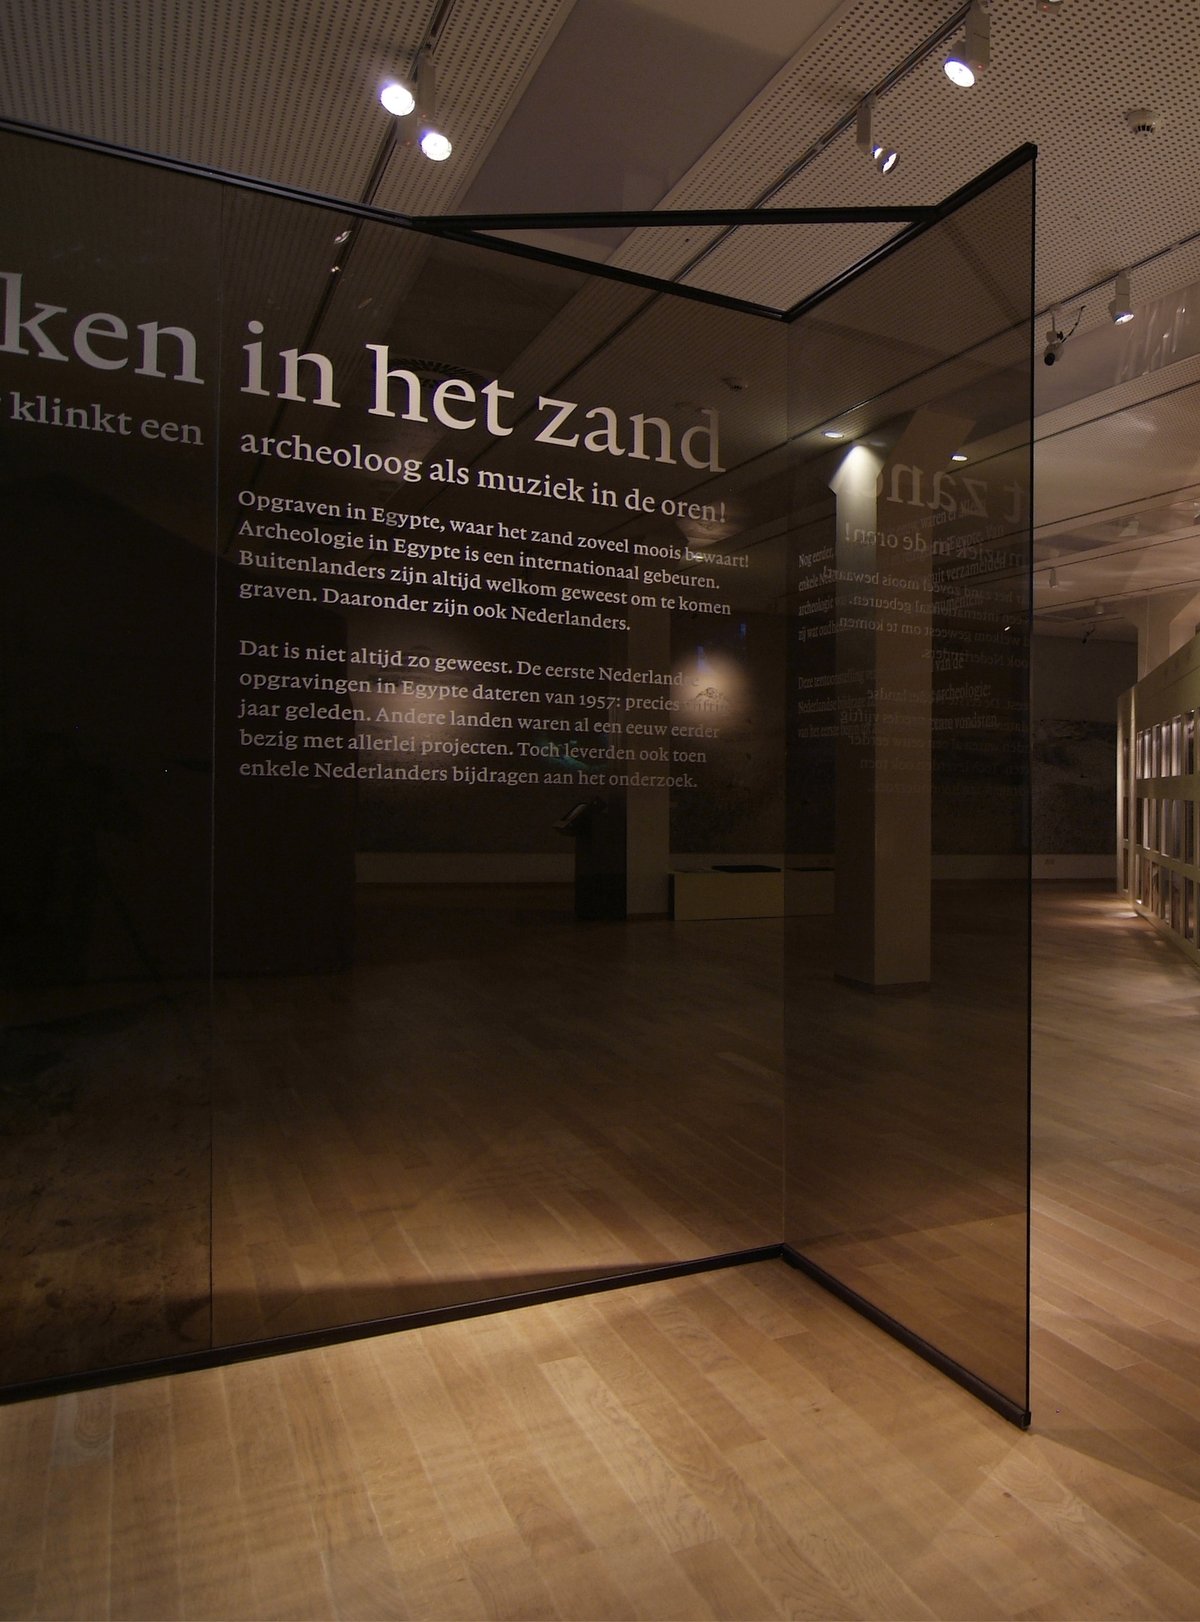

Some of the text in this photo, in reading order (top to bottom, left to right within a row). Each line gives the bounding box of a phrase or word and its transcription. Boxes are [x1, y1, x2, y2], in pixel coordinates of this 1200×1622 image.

[0, 271, 726, 473] ken in het zand
[9, 391, 205, 446] klinkt een
[240, 432, 727, 524] archeoloog als muziek in de oren!
[238, 490, 750, 568] Opgraven in Egypte, waar het zand zoveel moois bewaart!
[238, 519, 721, 590] Archeologie in Egypte is een internationaal gebeuren.
[238, 549, 732, 616] Buitenlanders zijn altijd welkom geweest om te komen
[239, 583, 632, 631] graven. Daaronder zijn ook Nederlanders.
[239, 640, 701, 687] Dat is niet altijd zo geweest. De eerste Nederland
[239, 671, 372, 695] opgravingen
[376, 678, 397, 694] in
[401, 680, 469, 701] Egypte
[472, 684, 541, 705] dateren
[545, 690, 576, 706] van
[578, 694, 621, 711] 1957:
[625, 695, 680, 713] precies
[237, 699, 720, 739] jaar geleden. Andere landen waren al een eeuw eerder
[239, 728, 708, 763] bezig met allerlei projecten. Toch leverden ook toen
[239, 759, 698, 789] enkele Nederlanders bijdragen aan het onderzoek.
